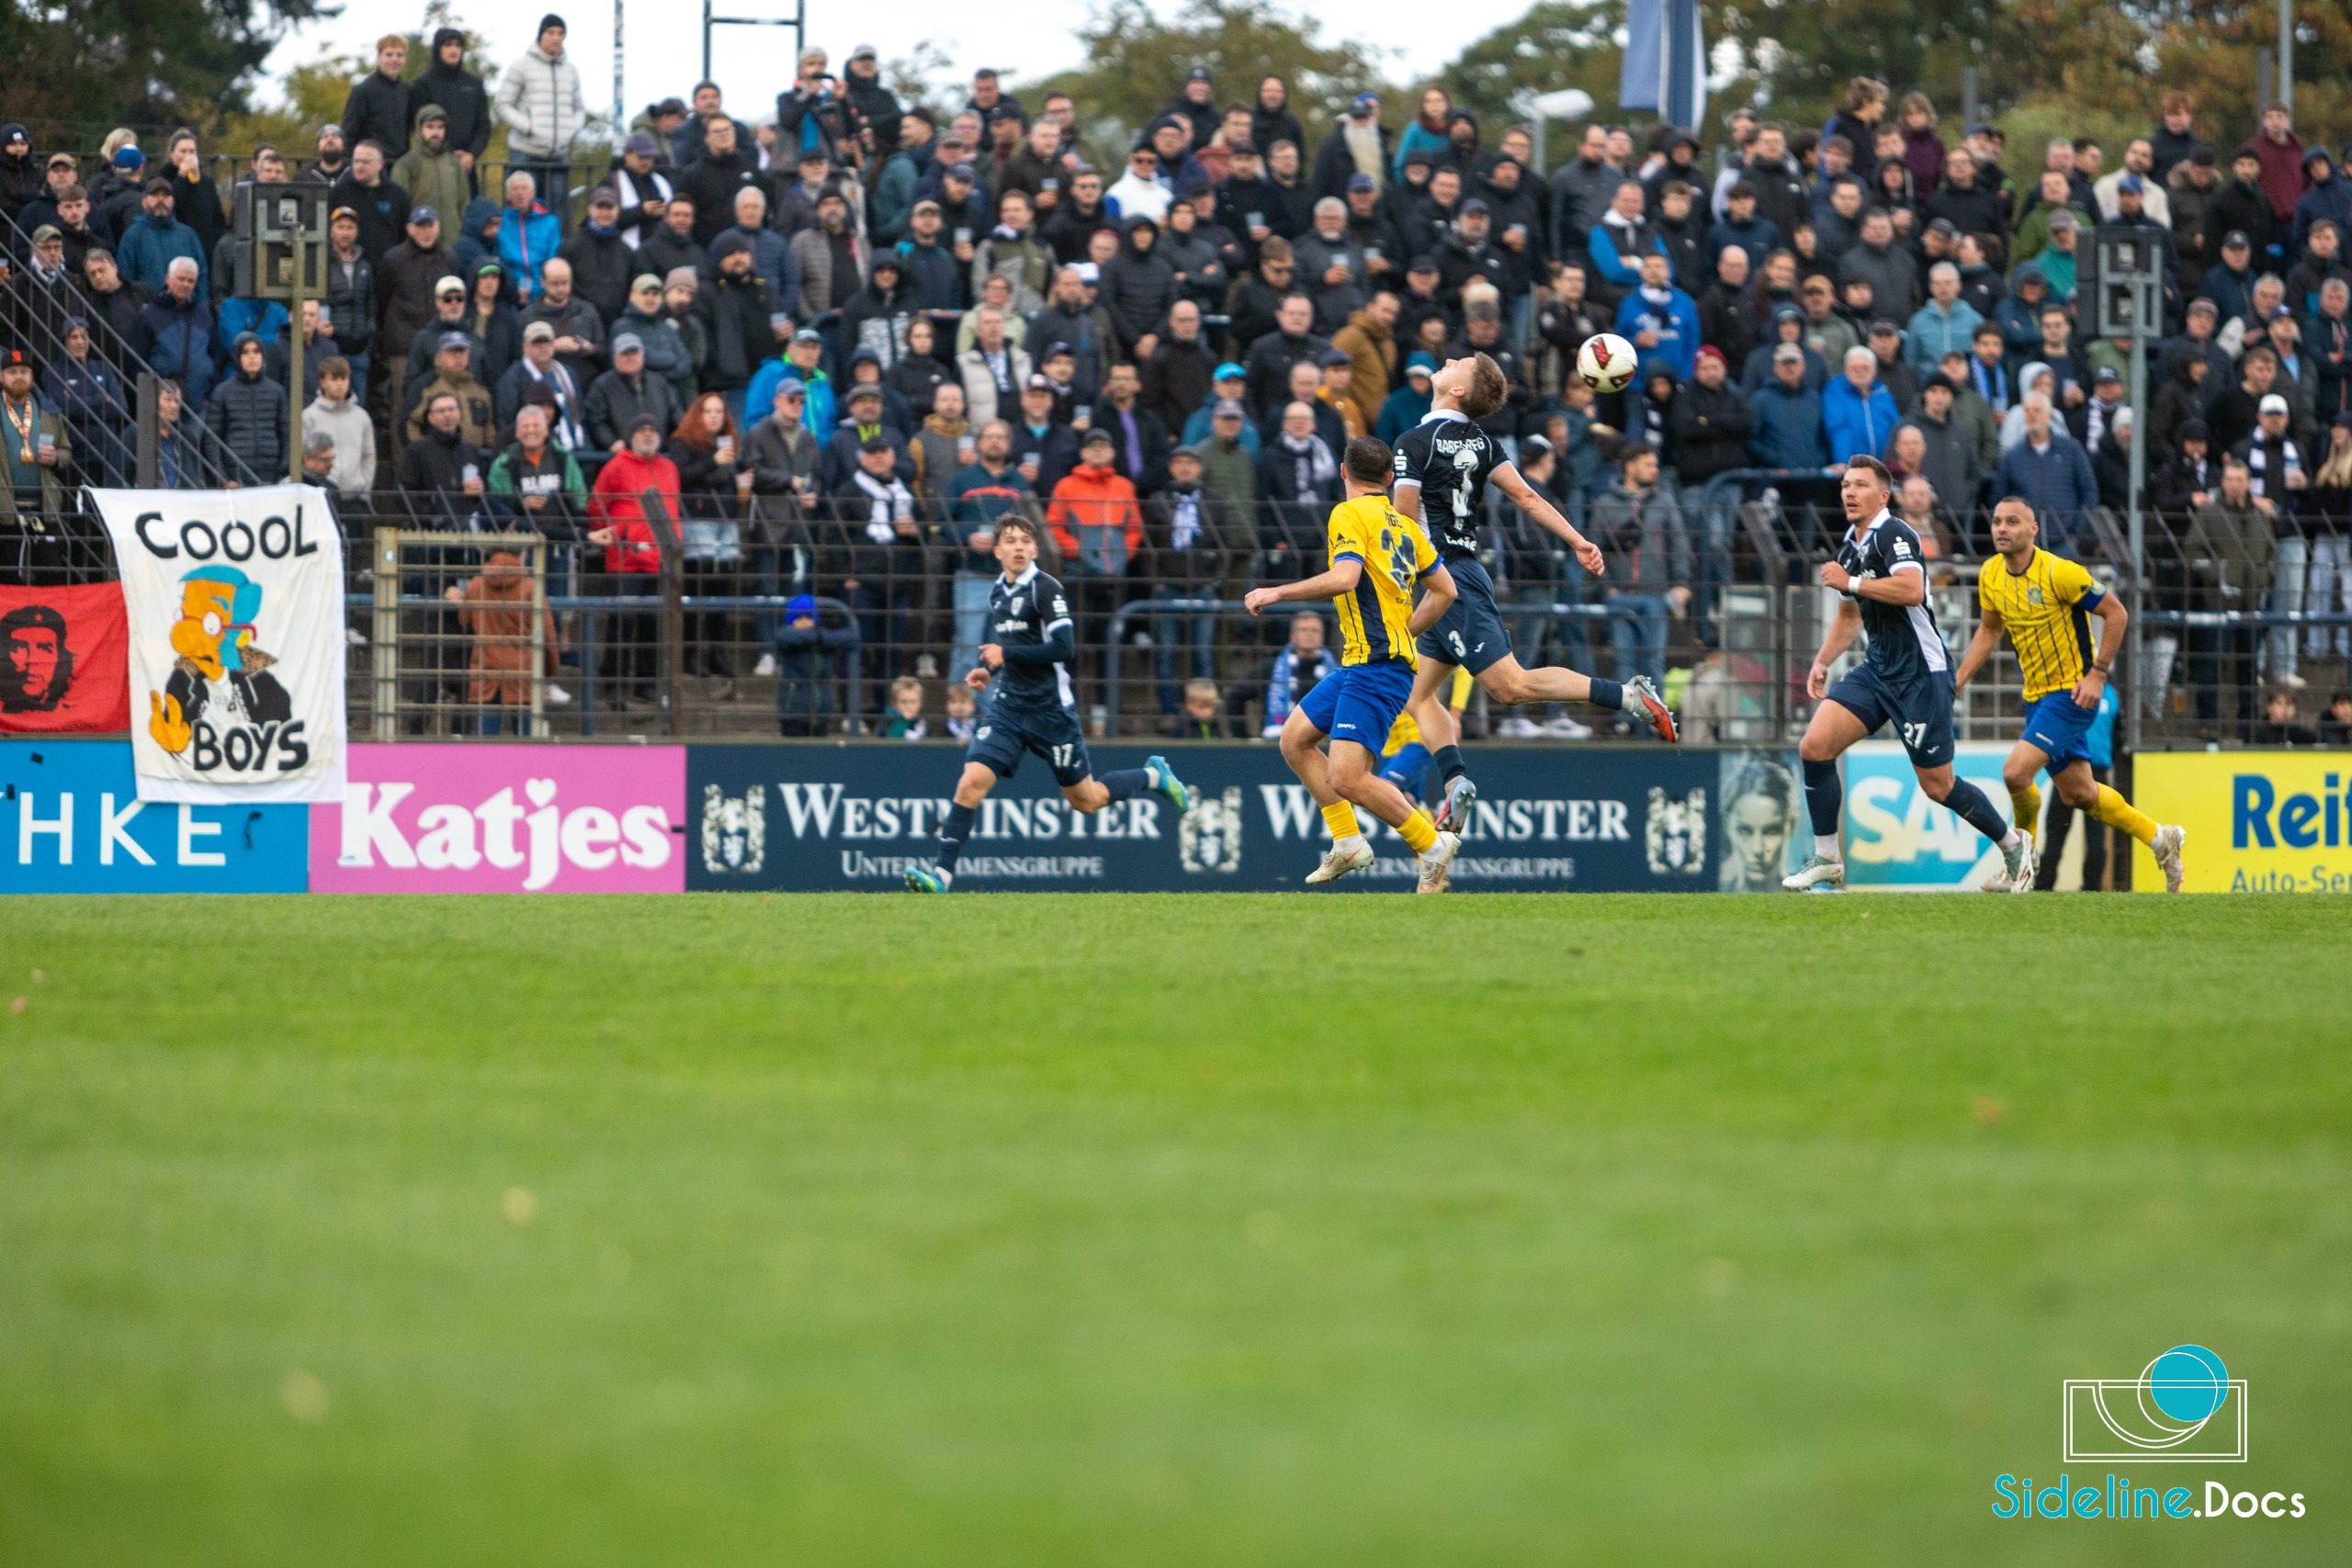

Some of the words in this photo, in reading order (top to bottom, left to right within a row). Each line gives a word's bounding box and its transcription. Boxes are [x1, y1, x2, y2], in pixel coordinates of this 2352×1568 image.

[135, 504, 318, 561] COOOL
[1448, 630, 1467, 658] 3
[193, 720, 309, 773] BOYS
[1052, 743, 1073, 767] 17
[1904, 721, 1928, 749] 27
[0, 791, 226, 865] HKE
[1260, 784, 1631, 840] WSNSTER
[1849, 775, 2011, 863] SAP
[337, 778, 672, 890] Katjes
[841, 850, 1102, 877] UNTERNMENSGRUPPE
[1319, 851, 1575, 878] ERNENSGRUPPE
[2230, 865, 2352, 894] Auto-Se
